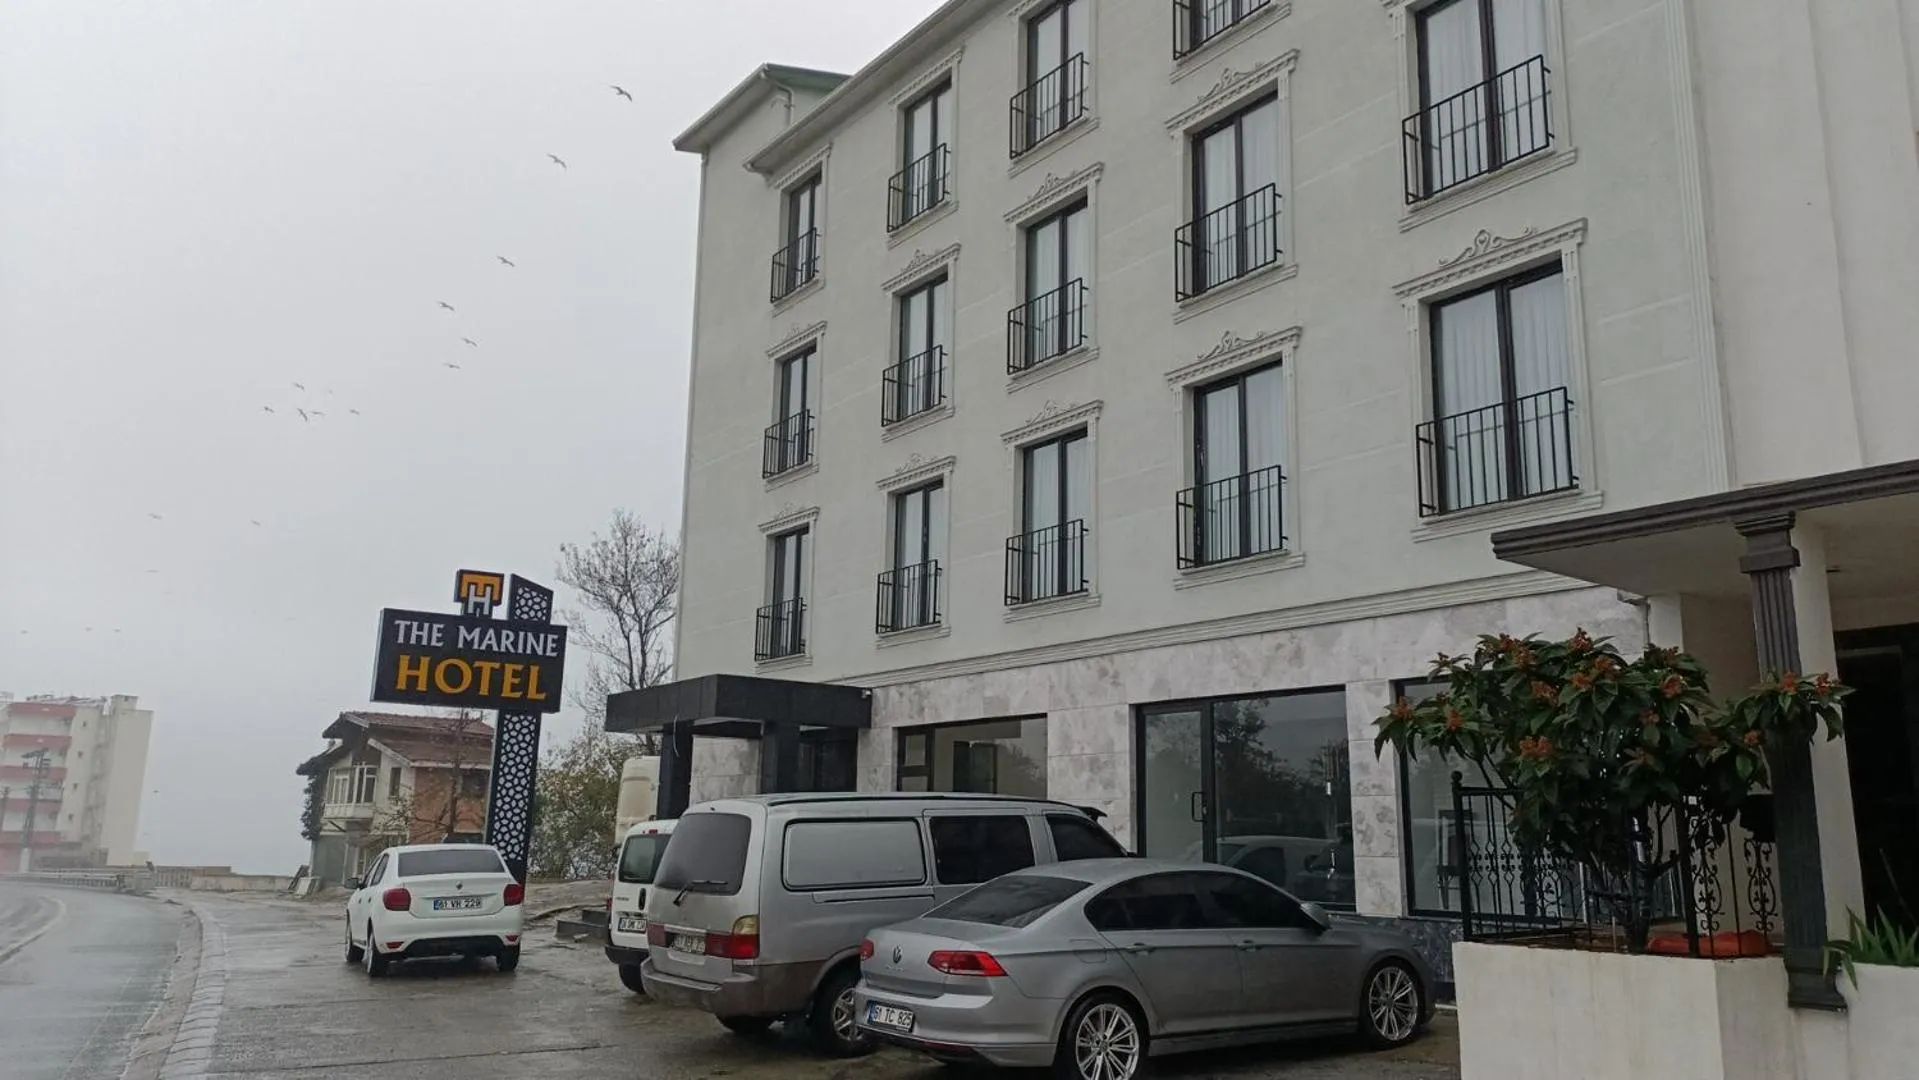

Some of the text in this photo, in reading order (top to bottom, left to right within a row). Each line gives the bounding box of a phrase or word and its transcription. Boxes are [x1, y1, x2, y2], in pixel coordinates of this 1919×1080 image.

[395, 620, 558, 657] THE MARINE
[396, 655, 547, 700] HOTEL
[885, 1008, 895, 1023] TC
